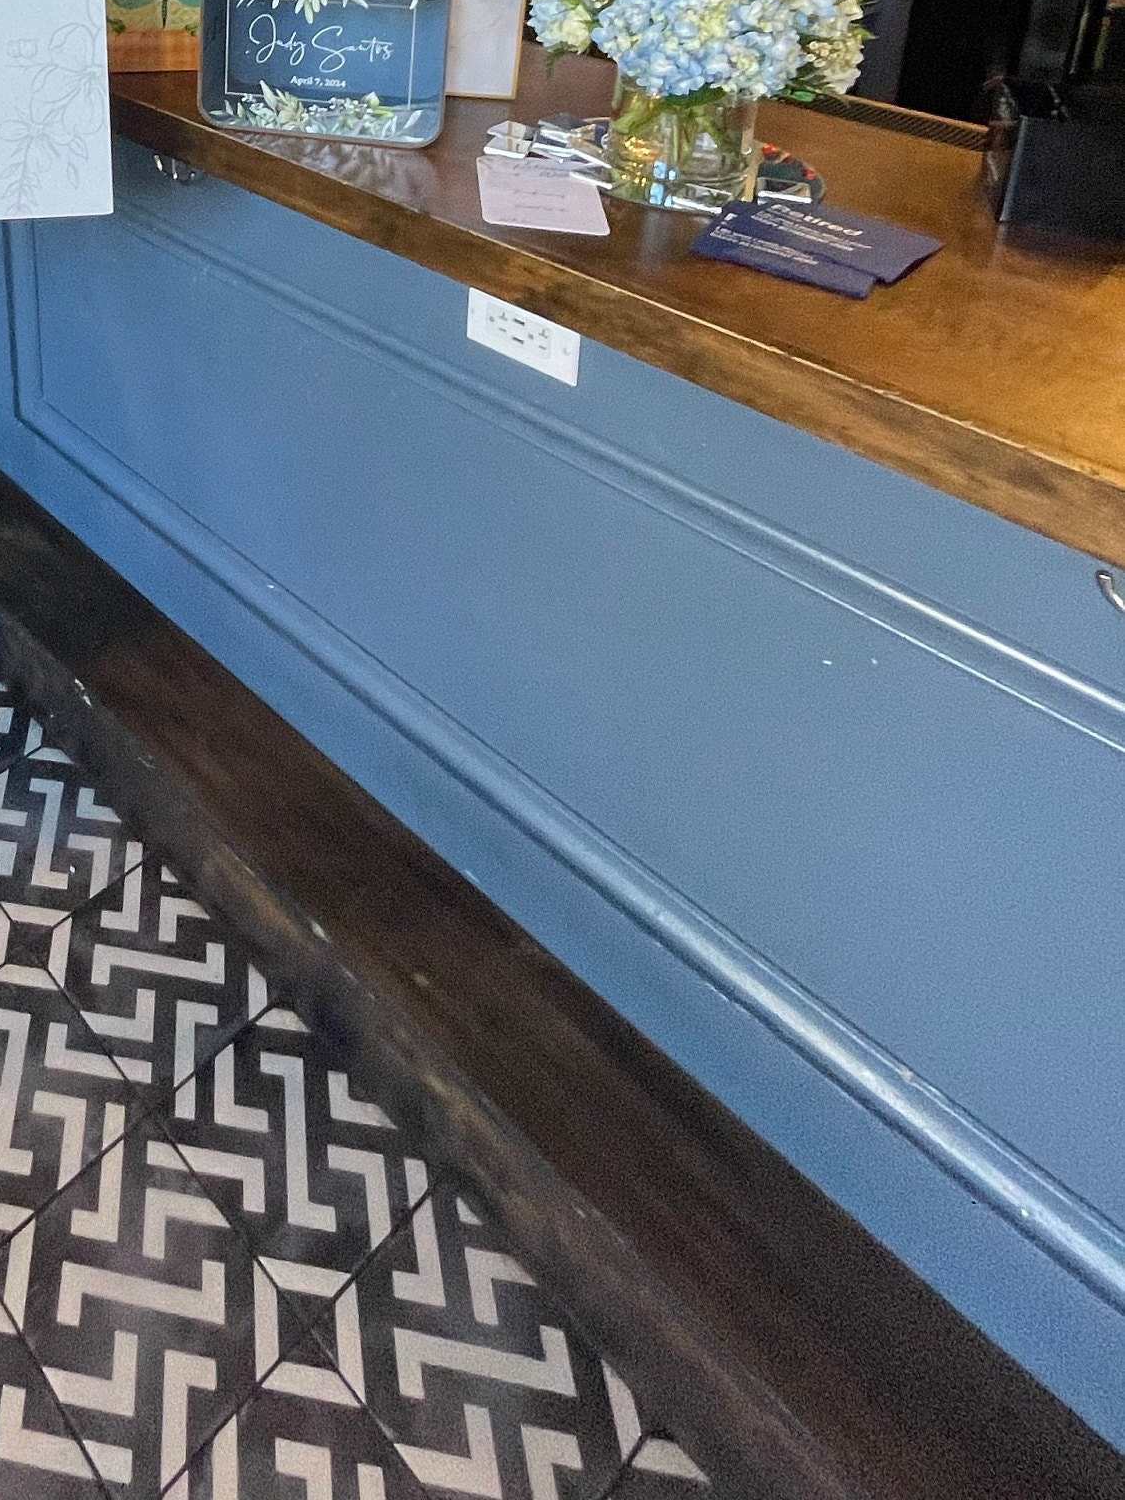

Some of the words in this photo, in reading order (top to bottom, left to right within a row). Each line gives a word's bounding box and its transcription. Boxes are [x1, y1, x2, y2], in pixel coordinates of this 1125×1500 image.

[248, 13, 307, 66] Judy
[311, 25, 395, 74] Santos
[290, 75, 313, 87] April
[314, 77, 323, 87] 7,
[324, 78, 347, 88] 2024
